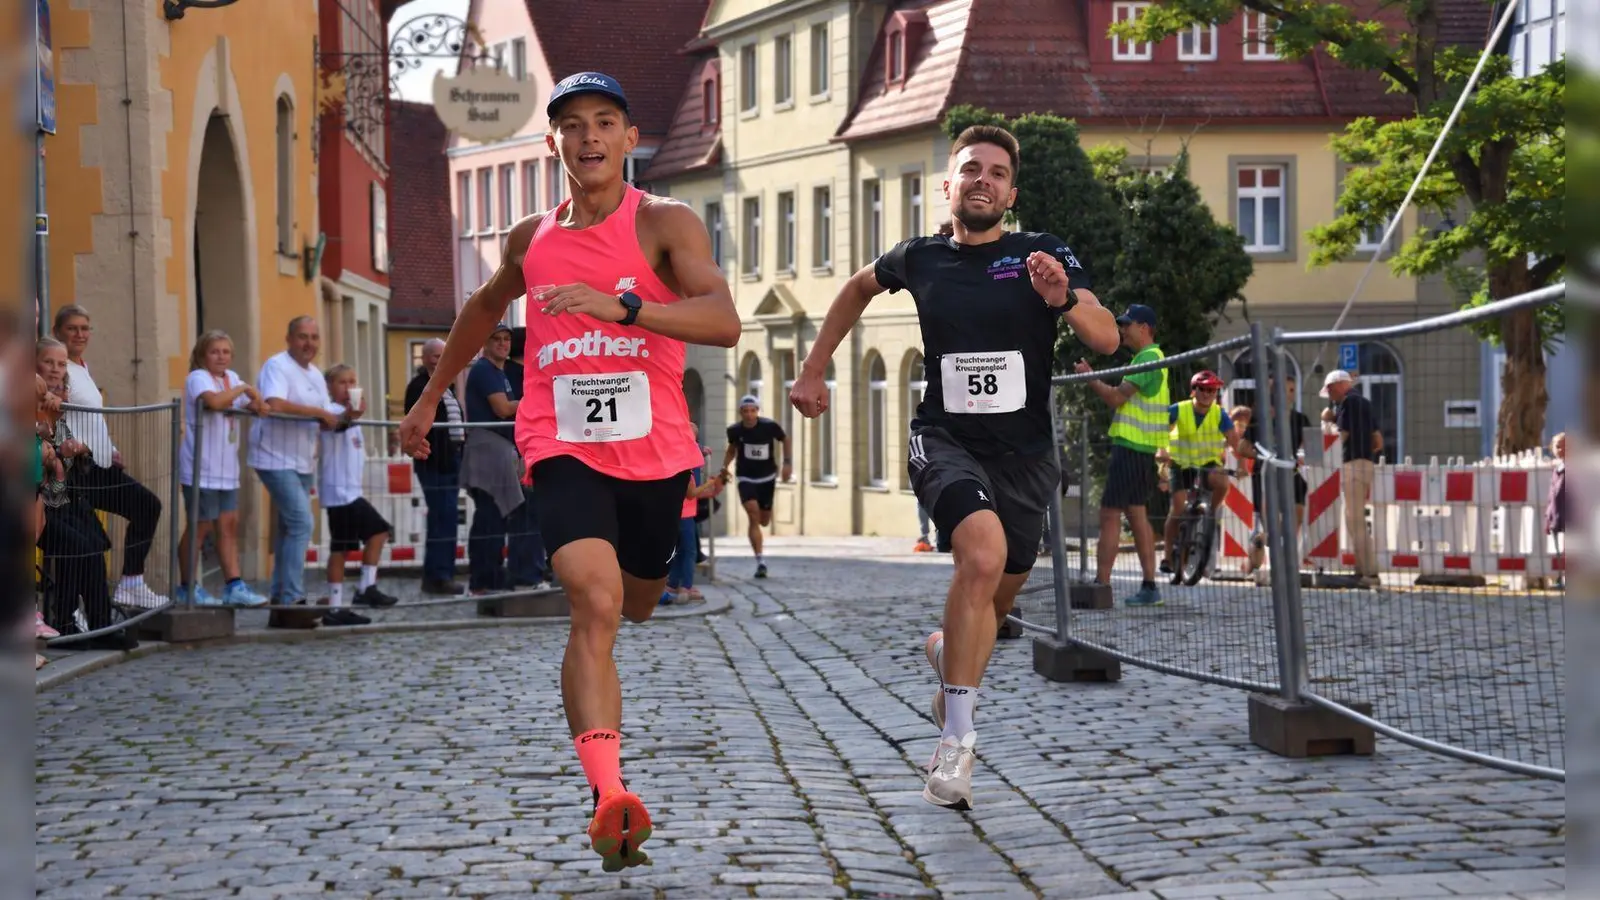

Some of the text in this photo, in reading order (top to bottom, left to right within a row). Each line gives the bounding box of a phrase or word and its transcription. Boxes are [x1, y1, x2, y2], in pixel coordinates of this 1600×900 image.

[450, 88, 519, 105] Schrannen
[467, 106, 500, 122] Saal
[536, 330, 650, 370] another.
[1343, 347, 1354, 366] P
[955, 356, 1006, 364] Feuchtwanger
[955, 364, 1007, 372] Kreuzganglauf
[572, 376, 630, 387] Feuchtwanger
[968, 374, 998, 396] 58
[571, 384, 631, 396] Kreuzganglauf
[585, 397, 618, 423] 21
[581, 733, 615, 743] cep
